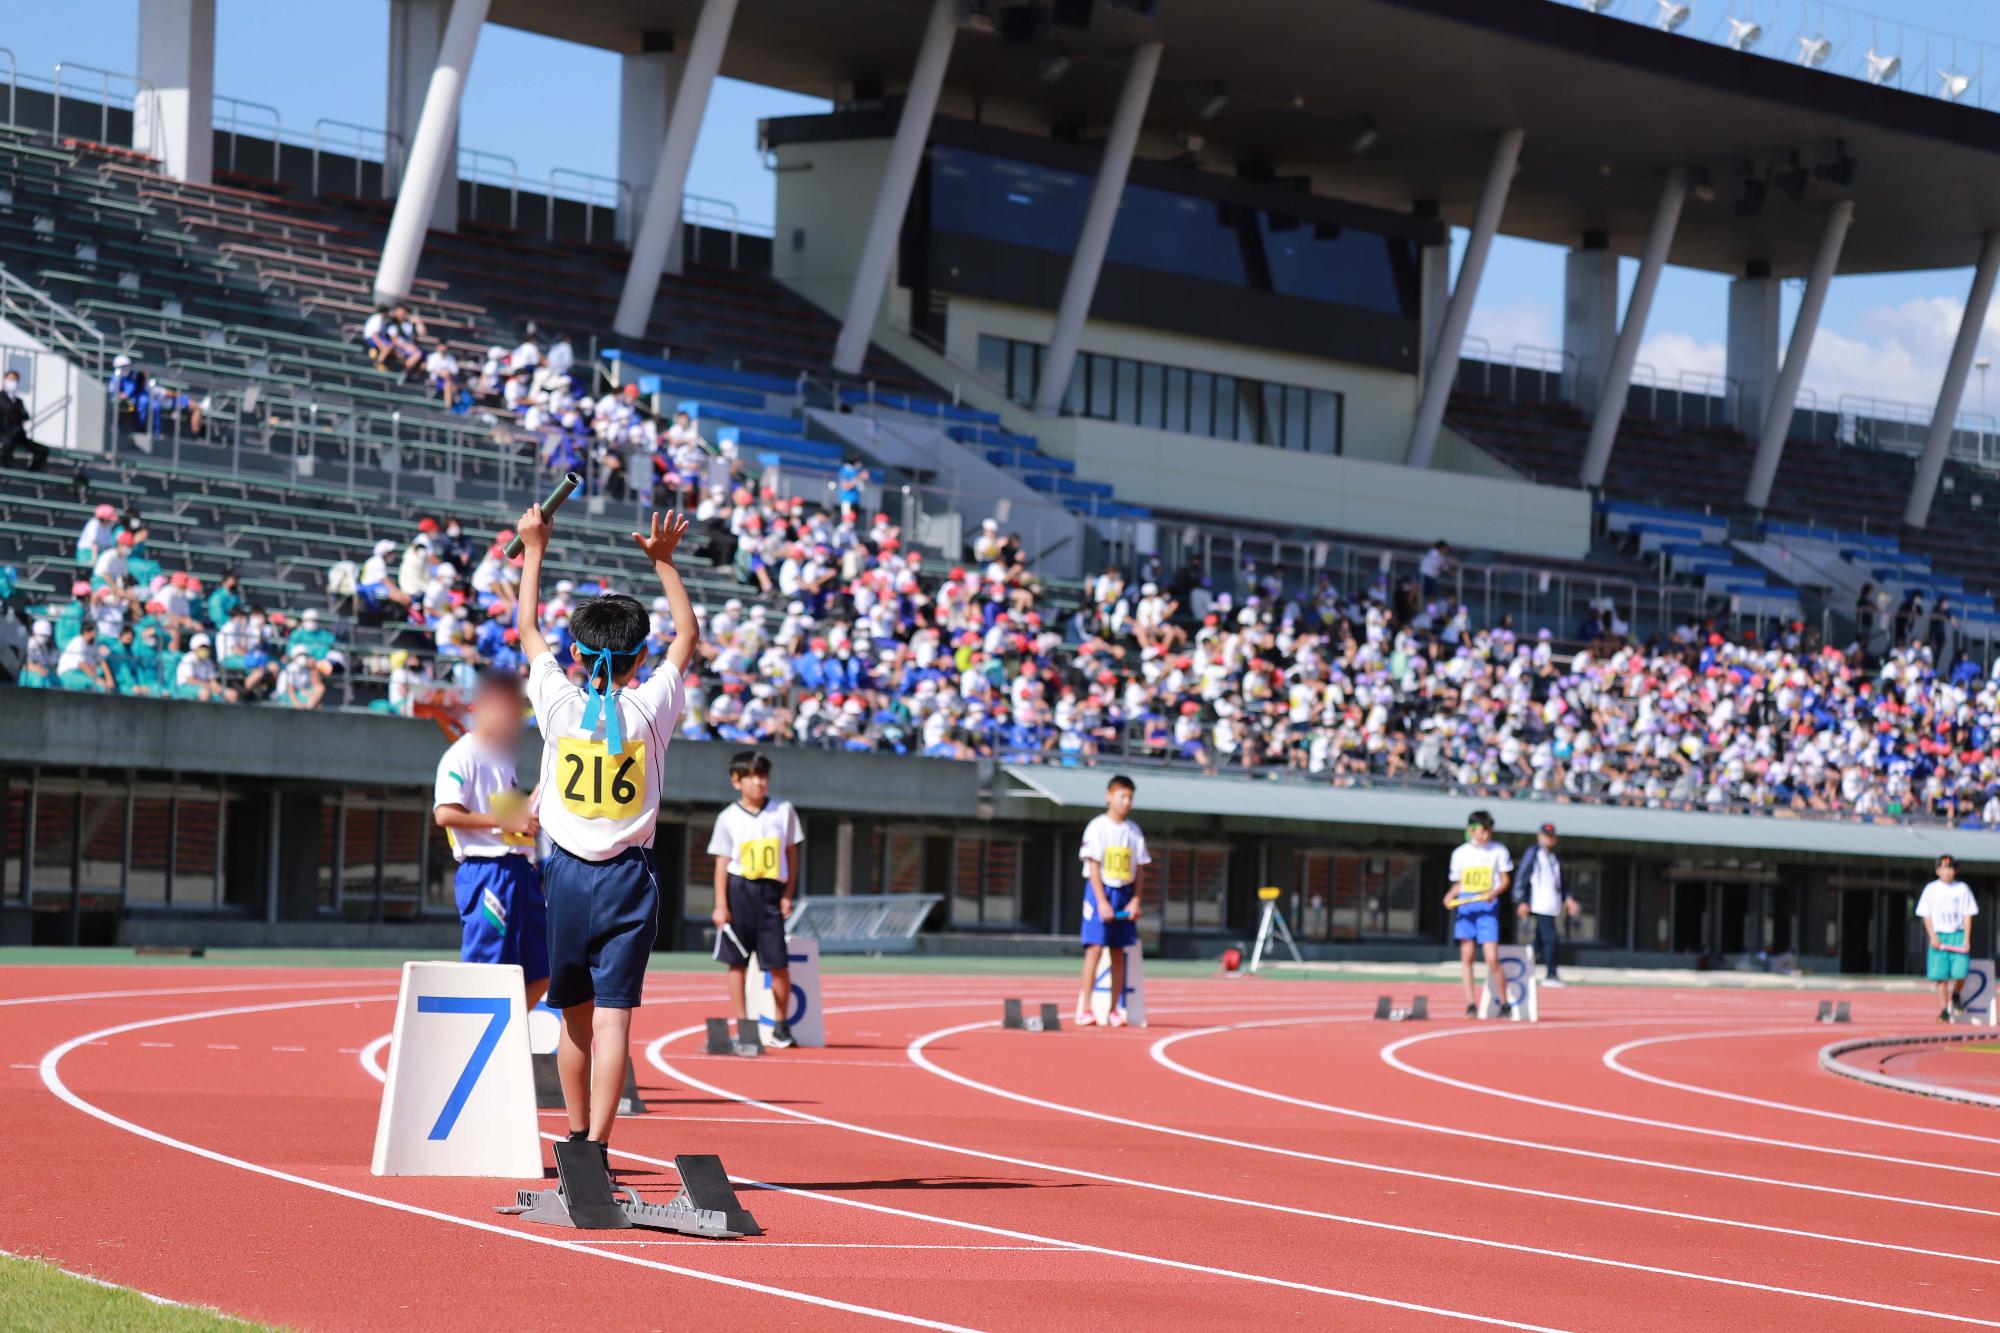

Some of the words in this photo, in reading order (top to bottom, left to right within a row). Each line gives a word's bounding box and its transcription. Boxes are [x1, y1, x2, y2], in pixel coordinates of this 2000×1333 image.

[564, 753, 636, 805] 216
[1494, 957, 1527, 1009] 3
[1963, 969, 1988, 1014] 2
[417, 995, 512, 1141] 7
